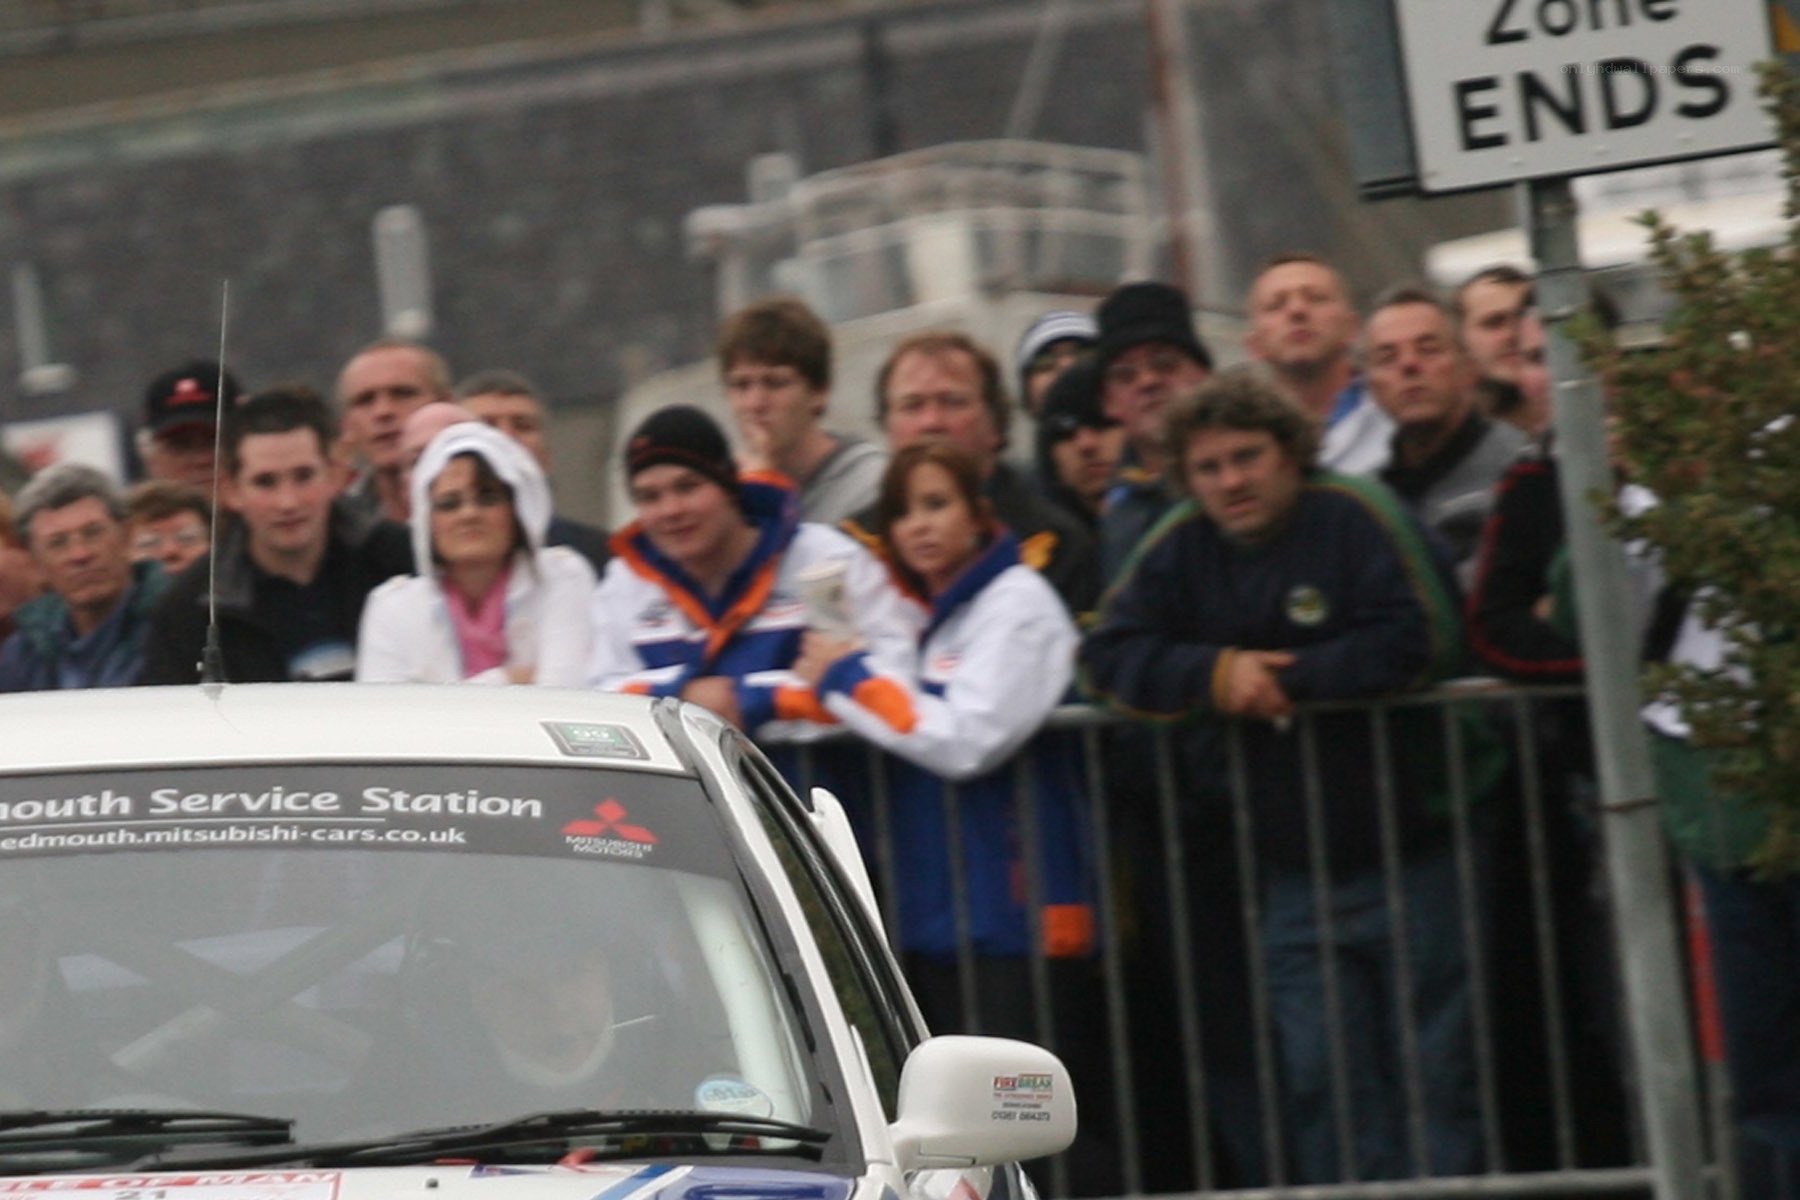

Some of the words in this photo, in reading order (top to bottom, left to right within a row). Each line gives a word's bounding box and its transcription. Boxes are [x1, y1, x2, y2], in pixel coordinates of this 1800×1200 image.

[1452, 43, 1731, 152] ENDS
[149, 786, 341, 815] Service
[361, 787, 542, 818] Station
[100, 1176, 166, 1188] OF
[202, 1172, 337, 1185] MAN
[114, 1189, 168, 1200] 21
